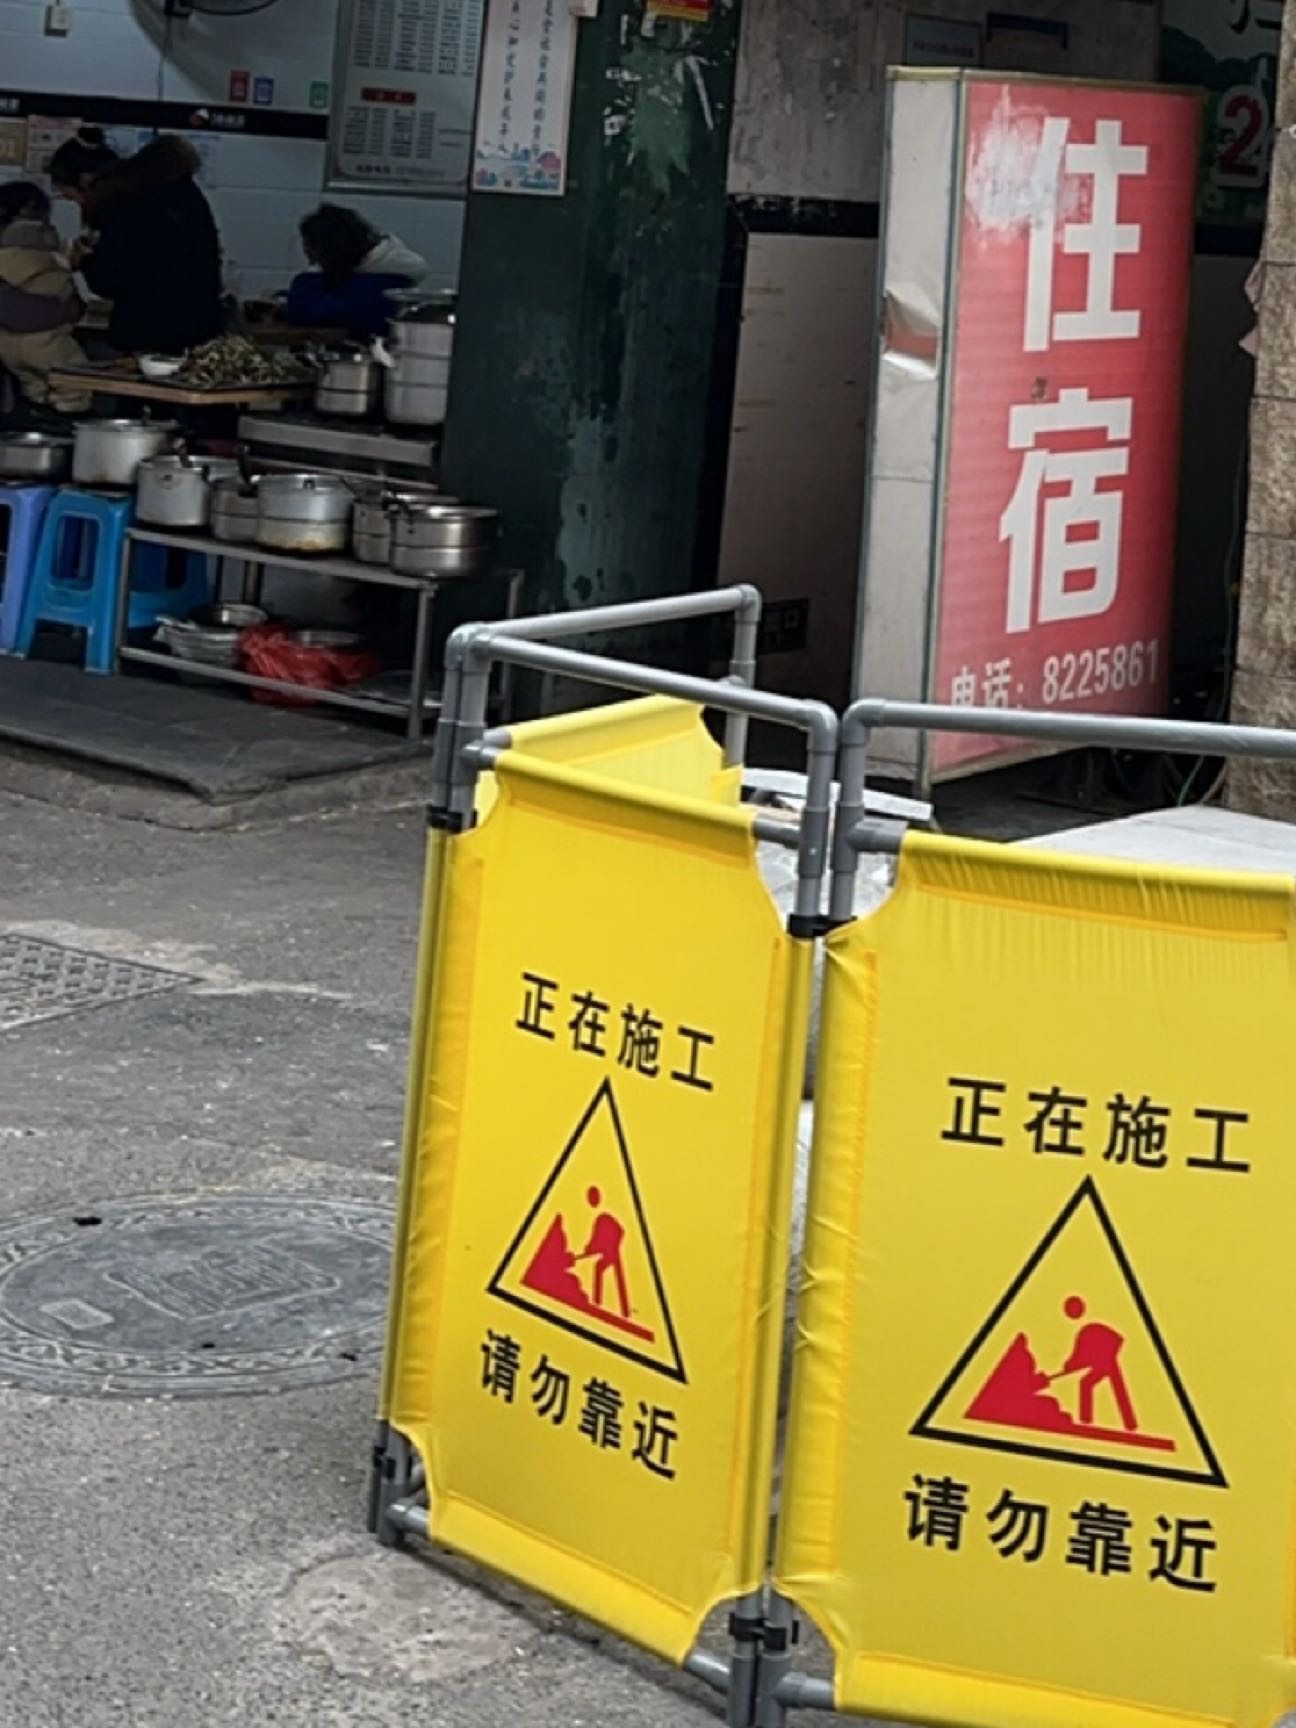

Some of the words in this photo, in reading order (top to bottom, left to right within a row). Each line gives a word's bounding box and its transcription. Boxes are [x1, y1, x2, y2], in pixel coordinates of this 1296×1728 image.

[998, 115, 1148, 634] 住宿
[1042, 638, 1159, 705] 8225861
[514, 971, 717, 1094] 正在施工
[941, 1076, 1253, 1175] 正在施工
[479, 1328, 679, 1482] 请勿靠近
[903, 1474, 1218, 1595] 请勿靠近
